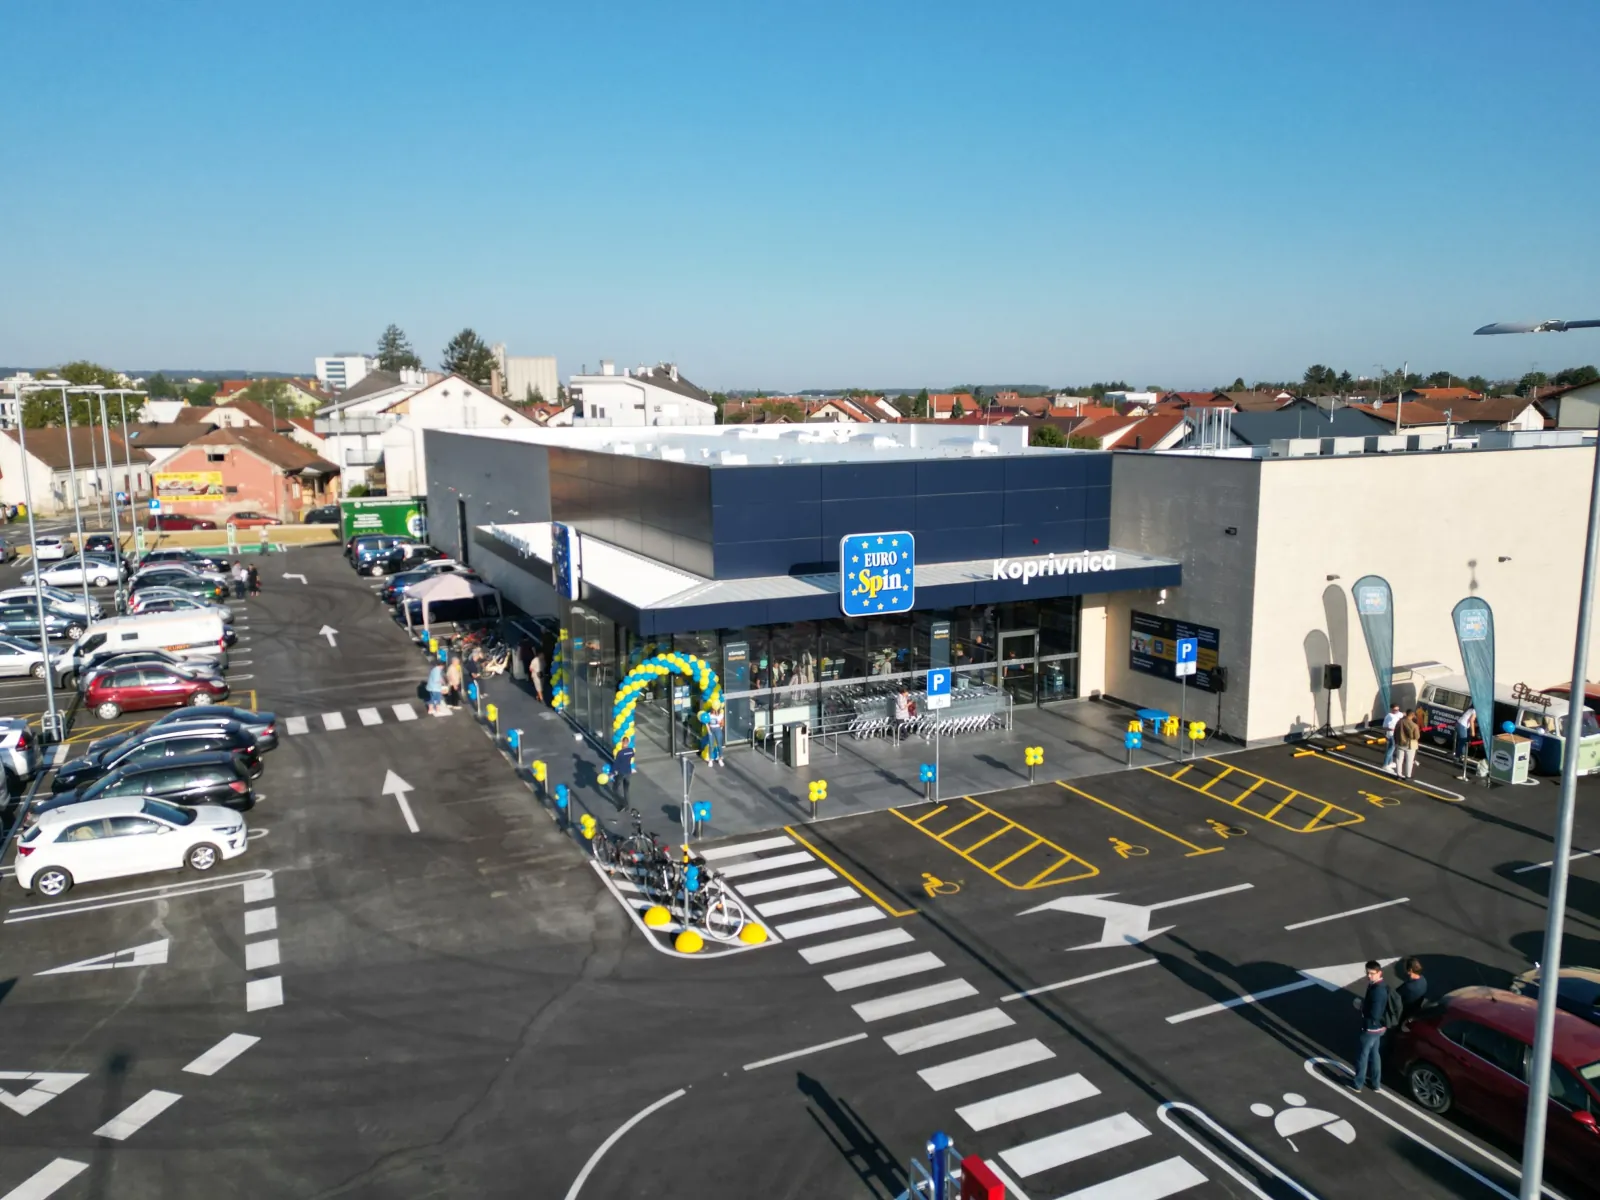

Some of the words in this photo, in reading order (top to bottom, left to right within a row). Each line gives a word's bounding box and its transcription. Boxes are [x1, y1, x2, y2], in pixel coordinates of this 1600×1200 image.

[864, 551, 898, 567] EURO
[993, 551, 1116, 584] Koprivnica
[858, 568, 902, 598] Spin
[1182, 643, 1192, 659] P
[934, 674, 944, 692] P
